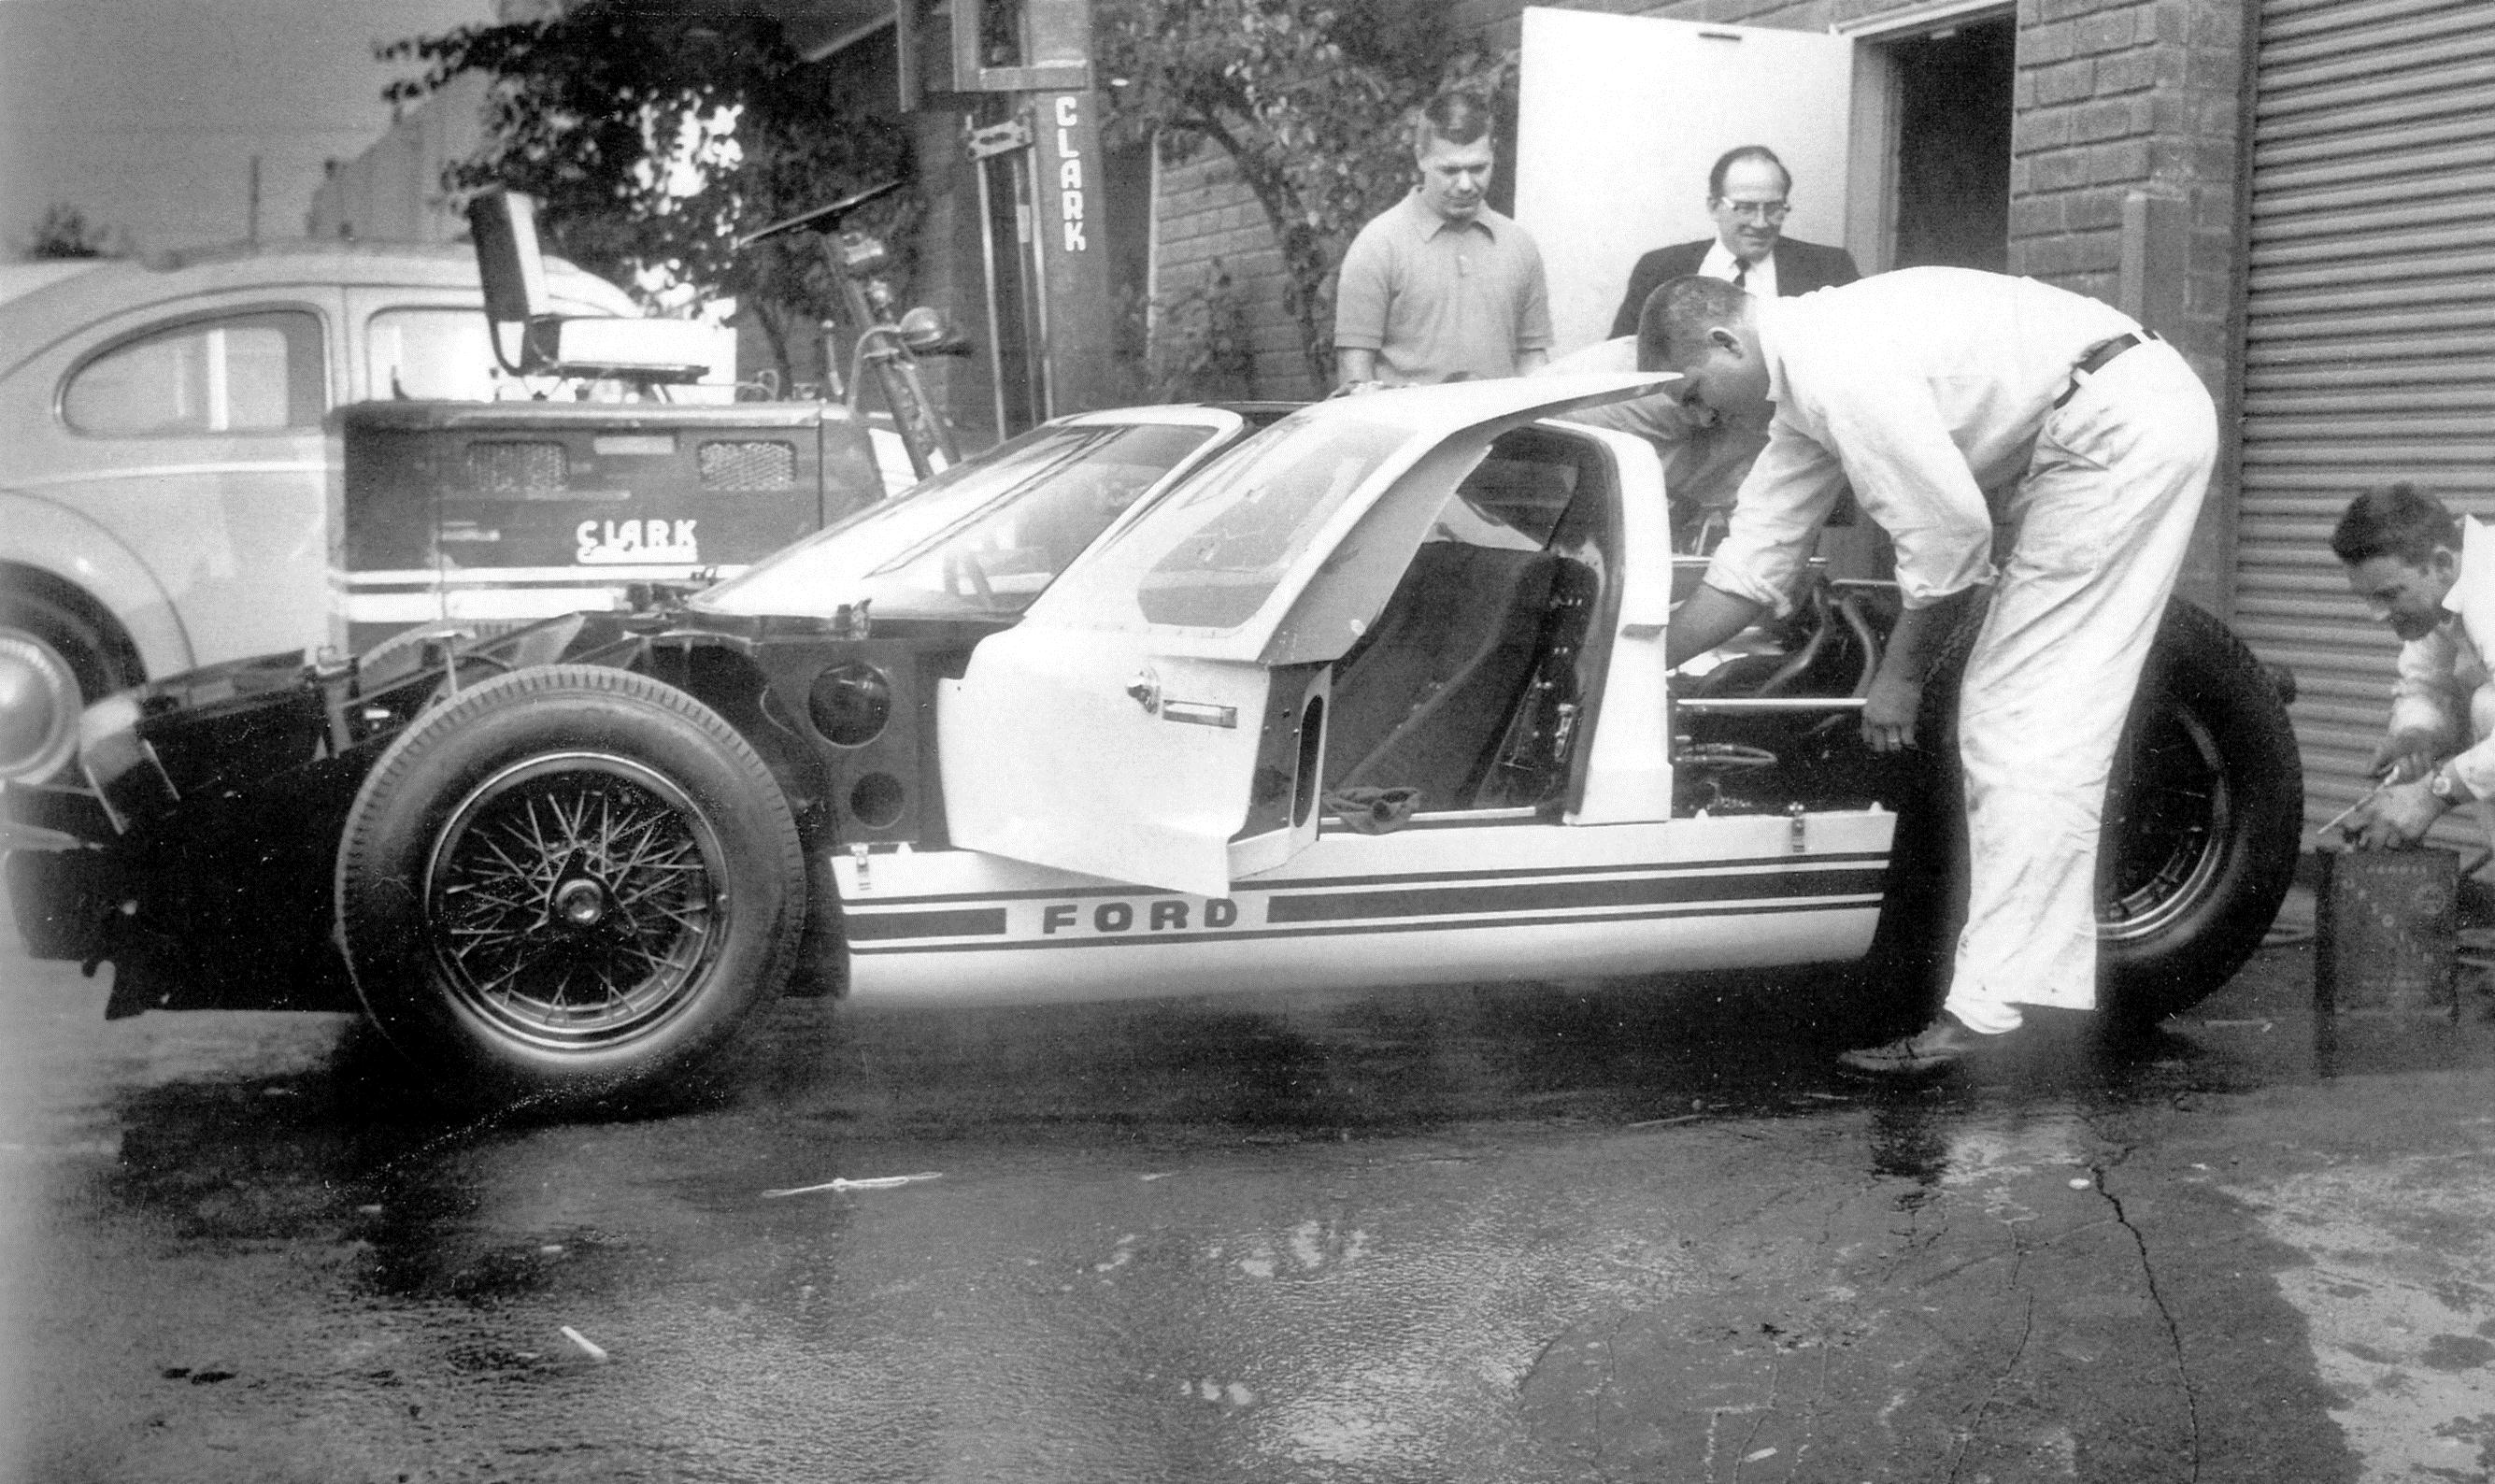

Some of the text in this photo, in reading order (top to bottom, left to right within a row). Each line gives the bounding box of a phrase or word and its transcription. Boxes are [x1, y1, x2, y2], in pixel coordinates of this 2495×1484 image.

[1056, 96, 1086, 251] CLARK
[577, 520, 698, 557] CLARK
[1043, 898, 1238, 935] FORD
